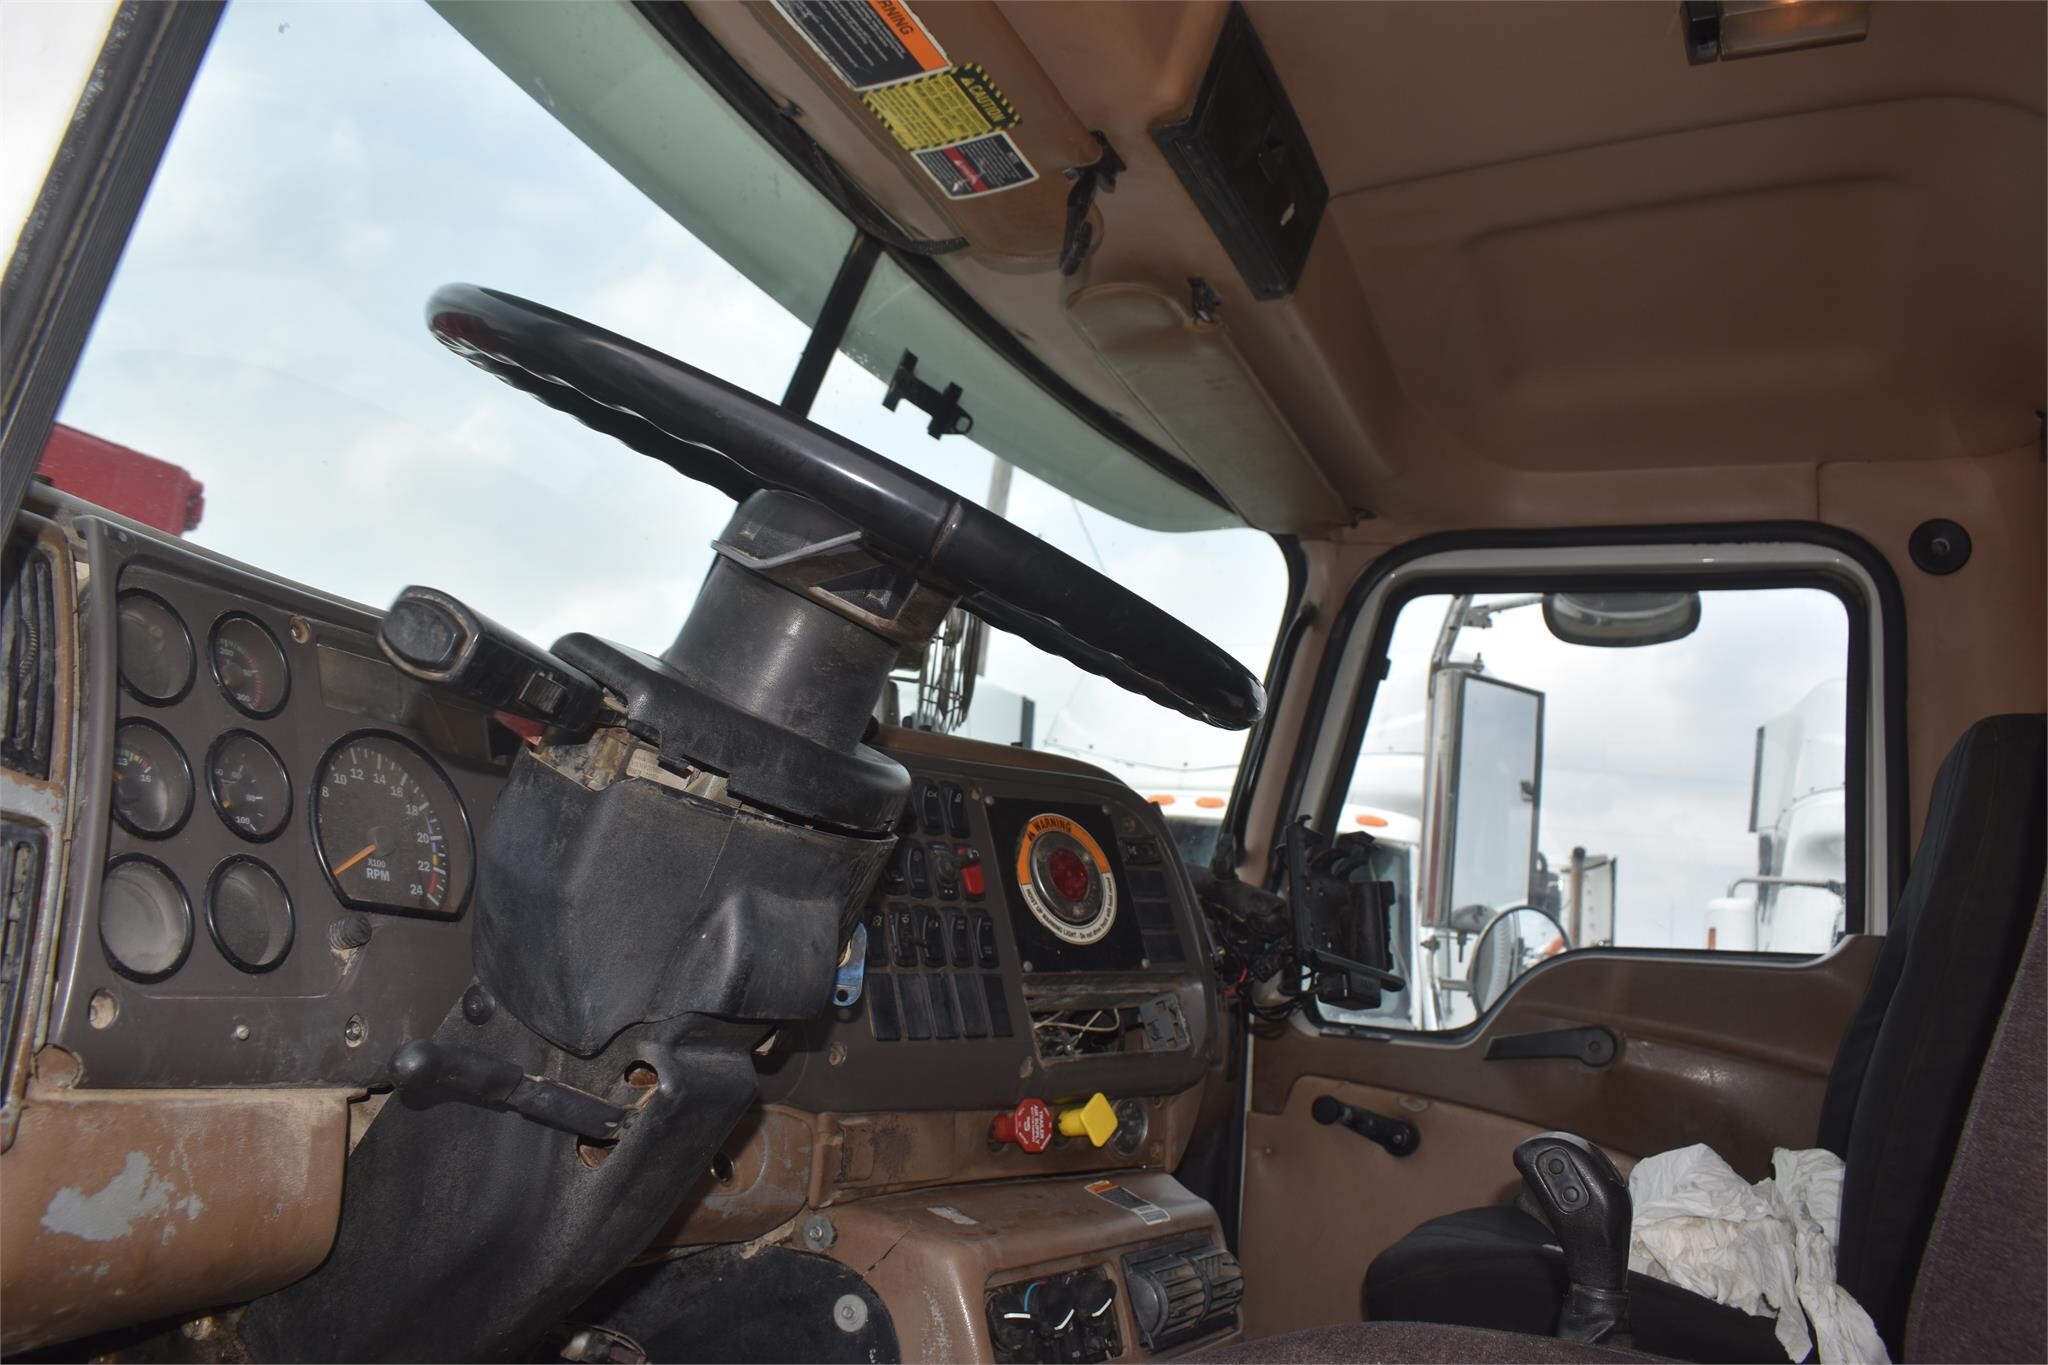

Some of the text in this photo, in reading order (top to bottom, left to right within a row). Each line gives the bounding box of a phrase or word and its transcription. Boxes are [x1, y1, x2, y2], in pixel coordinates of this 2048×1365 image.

[878, 0, 914, 35] RNING
[968, 85, 1006, 123] CAUTION
[333, 773, 347, 785] 10
[350, 768, 365, 780] 12
[373, 773, 386, 785] 14
[321, 786, 330, 798] 8
[405, 804, 418, 816] 18
[1034, 819, 1073, 833] WARNING
[416, 831, 430, 844] 20
[367, 858, 386, 868] X100
[417, 860, 431, 872] 22
[366, 867, 391, 882] RPM
[410, 884, 423, 895] 24
